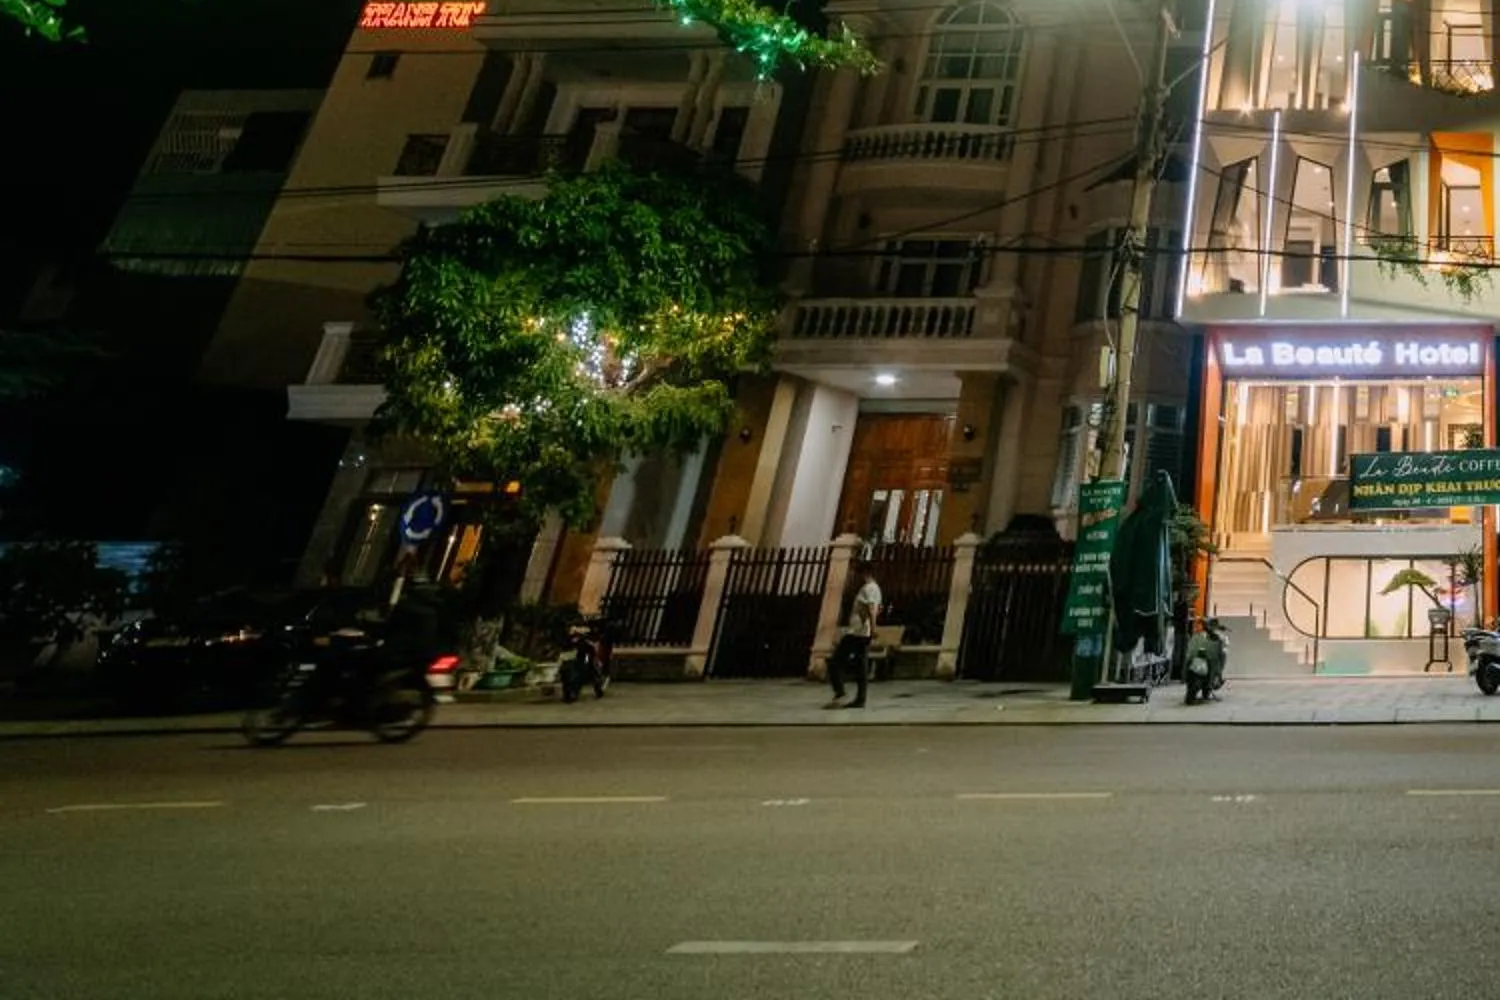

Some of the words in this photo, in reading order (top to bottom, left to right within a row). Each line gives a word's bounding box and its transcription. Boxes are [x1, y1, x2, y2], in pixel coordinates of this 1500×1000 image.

[1223, 342, 1264, 366] La
[1271, 340, 1382, 366] Beauté
[1395, 341, 1480, 366] Hotel
[1425, 481, 1462, 494] KHAI
